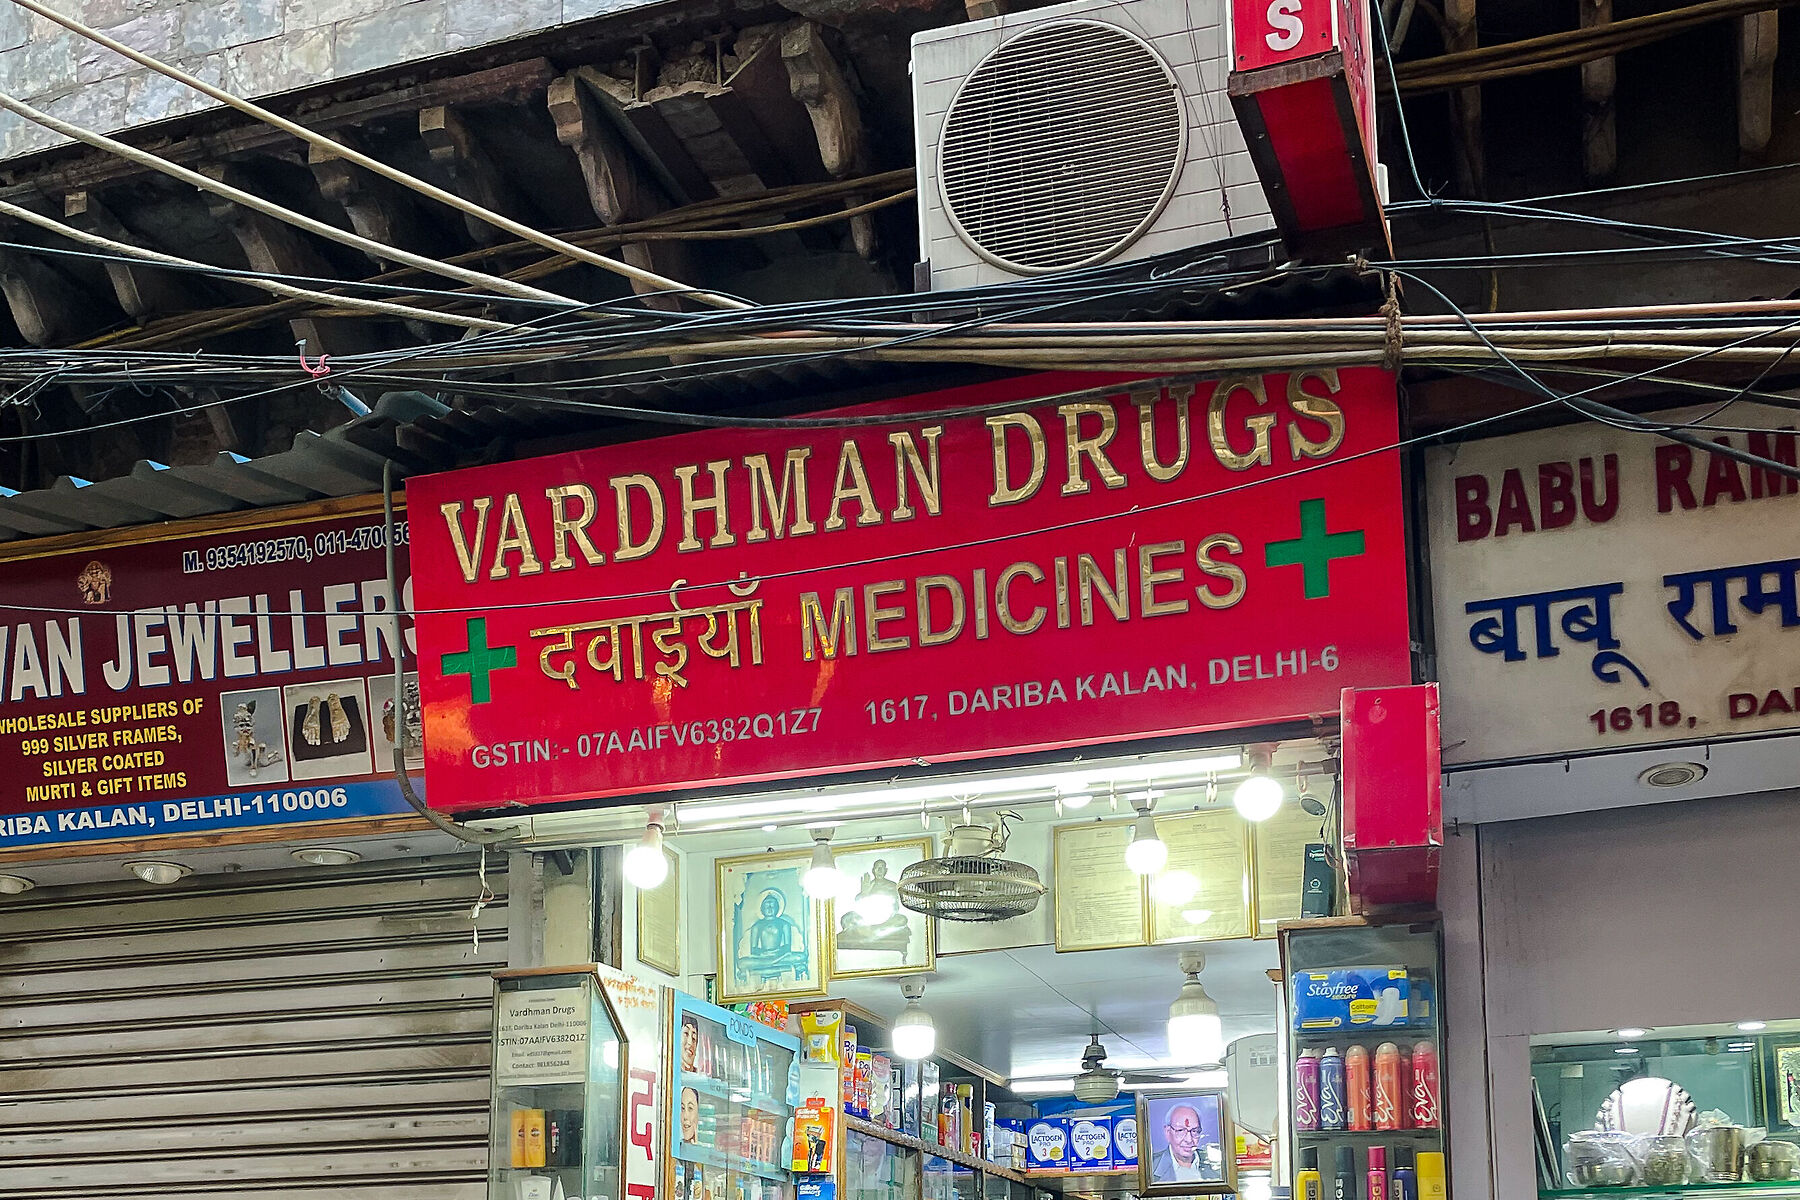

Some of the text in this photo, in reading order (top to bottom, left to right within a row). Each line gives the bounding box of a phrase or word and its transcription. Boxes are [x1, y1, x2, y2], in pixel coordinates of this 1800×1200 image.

[1265, 0, 1304, 51] S
[440, 368, 1347, 583] VARDHMAN DRUGS
[1454, 453, 1619, 543] BABU
[184, 550, 204, 573] M.
[207, 535, 313, 571] 9354192570,
[800, 533, 1247, 663] MEDICINES
[530, 572, 765, 690] दवाईयाँ
[1465, 581, 1651, 689] बाबू
[865, 645, 1340, 724] 1617, DARIBA KALAN, DELHI-6
[90, 701, 180, 726] SUPPLIERS
[182, 697, 204, 715] OF
[1589, 700, 1697, 735] 1618,
[22, 725, 182, 756] 999 SILVER FRAMES,
[576, 707, 823, 758] 07AAIFV6382Q1Z7
[43, 750, 165, 777] SILVER COATED
[26, 771, 187, 803] MURTI & GIFT ITEMS
[57, 805, 156, 833] KALAN,
[163, 787, 348, 823] DELHI-110006
[1306, 982, 1360, 998] Stayfree
[510, 1006, 576, 1018] Vardhman Drugs
[1031, 1134, 1062, 1144] LACTOGEN
[1042, 1148, 1047, 1157] 3
[1075, 1132, 1106, 1143] LACTOGEN
[1085, 1147, 1091, 1156] 2
[1130, 1145, 1134, 1154] 1
